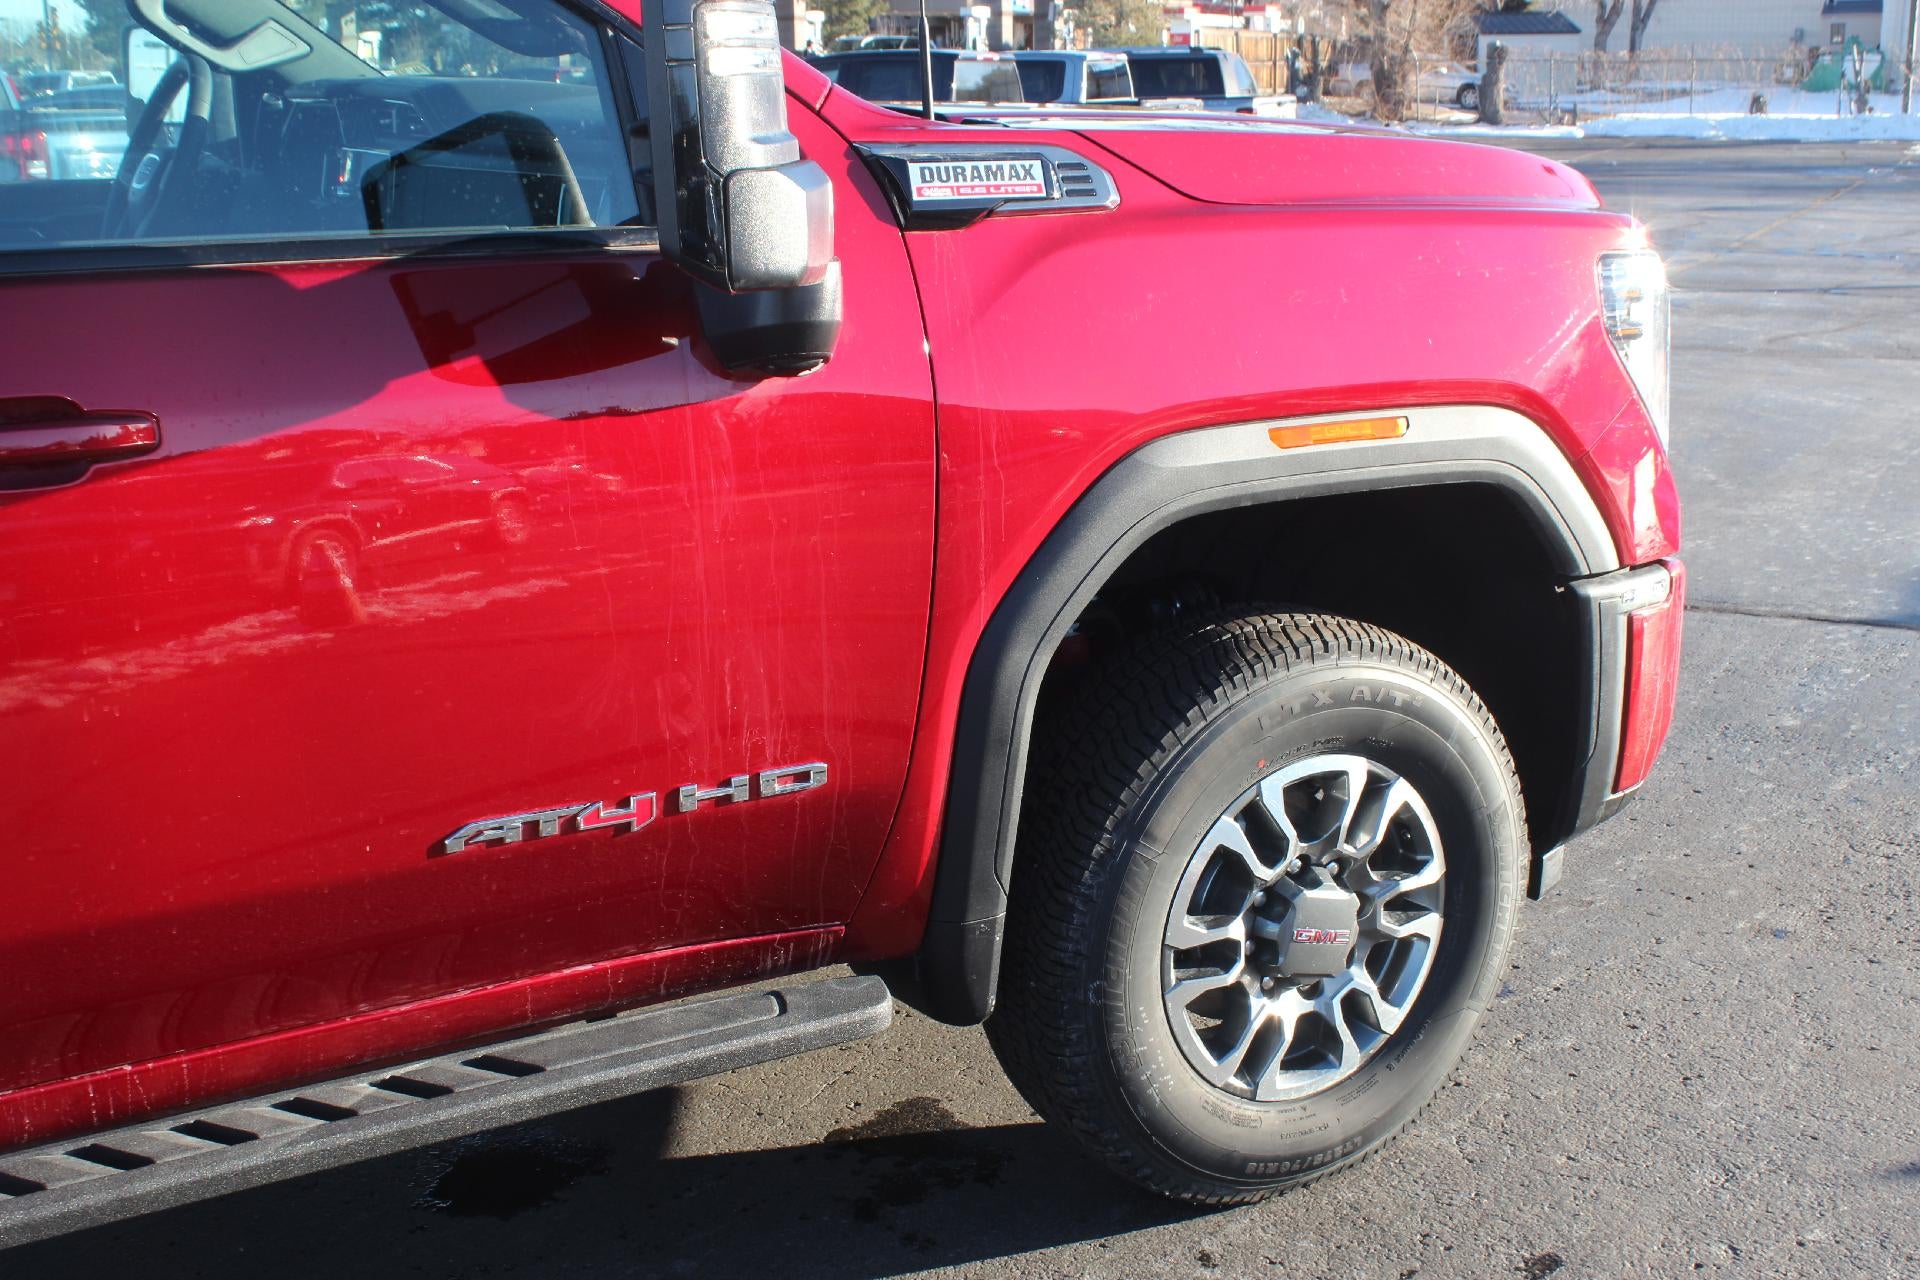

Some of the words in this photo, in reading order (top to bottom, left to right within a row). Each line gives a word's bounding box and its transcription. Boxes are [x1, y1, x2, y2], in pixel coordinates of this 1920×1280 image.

[919, 163, 1037, 184] DURAMAX
[989, 184, 1037, 194] LITER
[444, 791, 657, 854] AT4
[678, 762, 828, 812] HD
[1293, 927, 1351, 945] GMC
